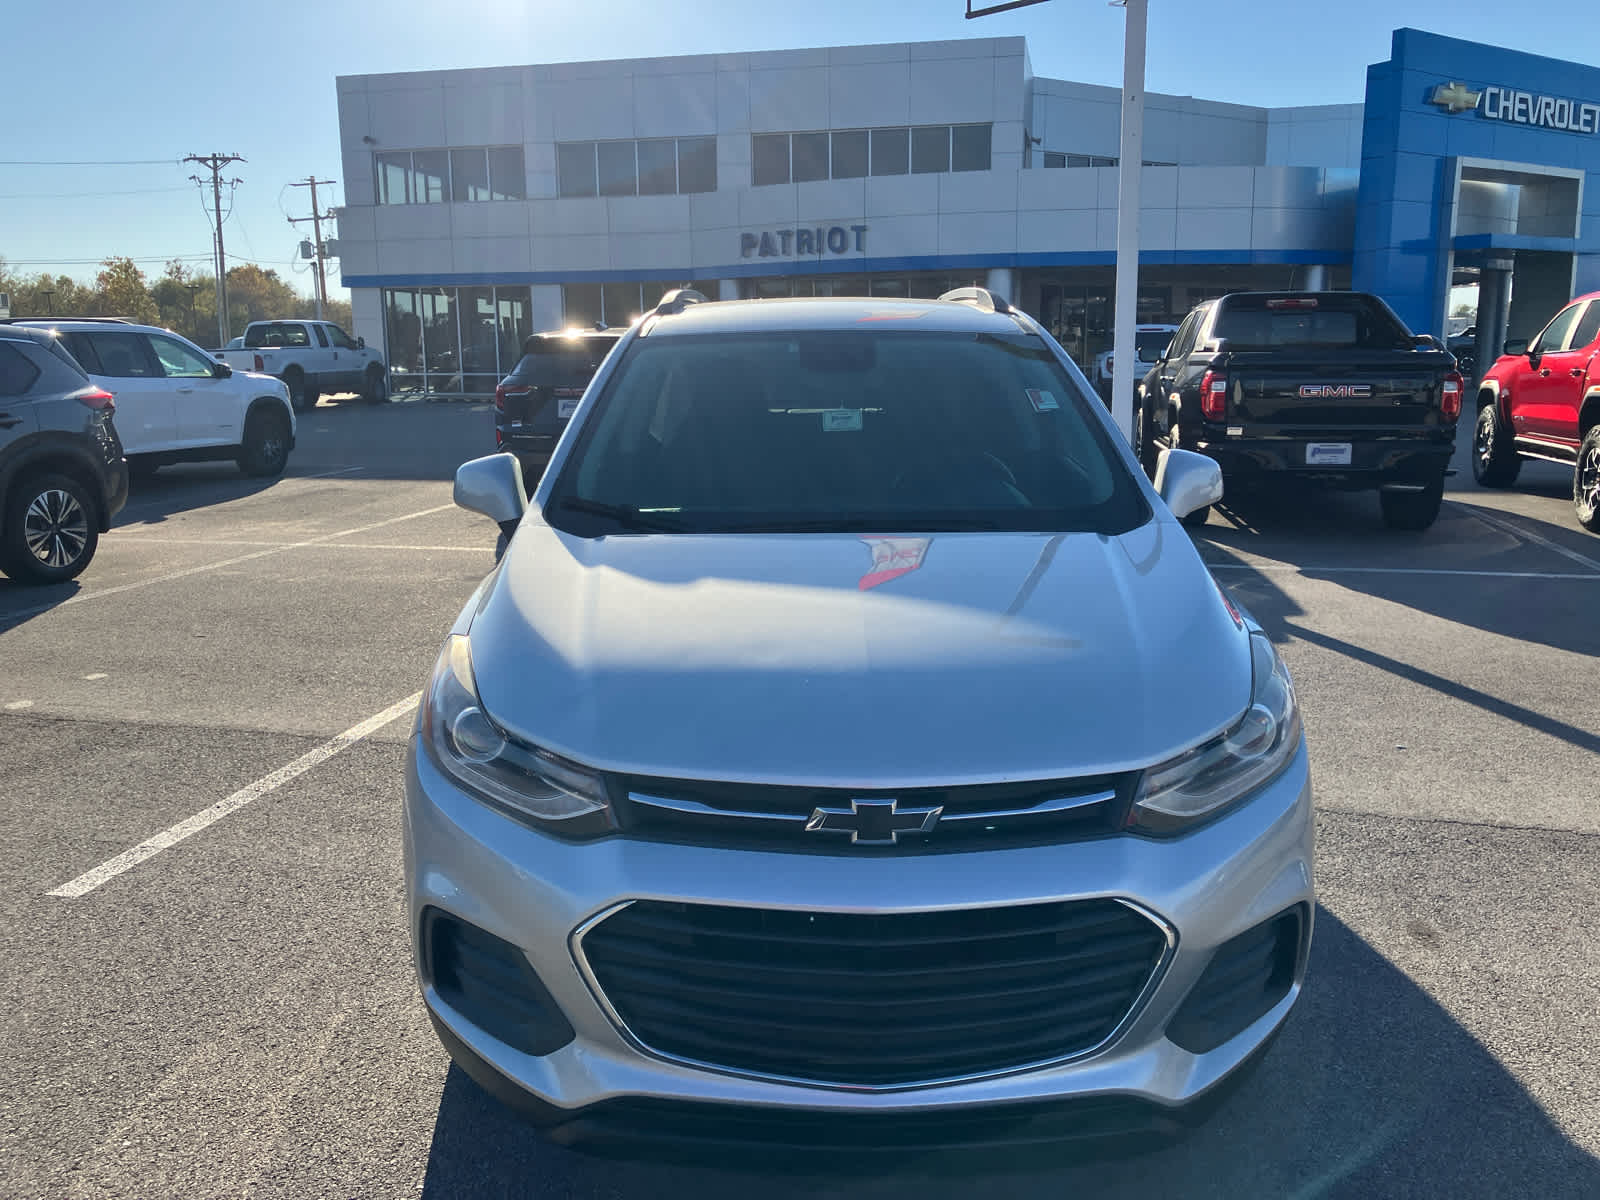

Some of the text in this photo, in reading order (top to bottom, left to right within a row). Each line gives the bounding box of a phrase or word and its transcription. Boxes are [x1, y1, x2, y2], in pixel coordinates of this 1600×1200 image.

[1484, 86, 1600, 134] CHEVROLET
[740, 225, 868, 258] PATRIOT
[1299, 384, 1372, 398] GMC
